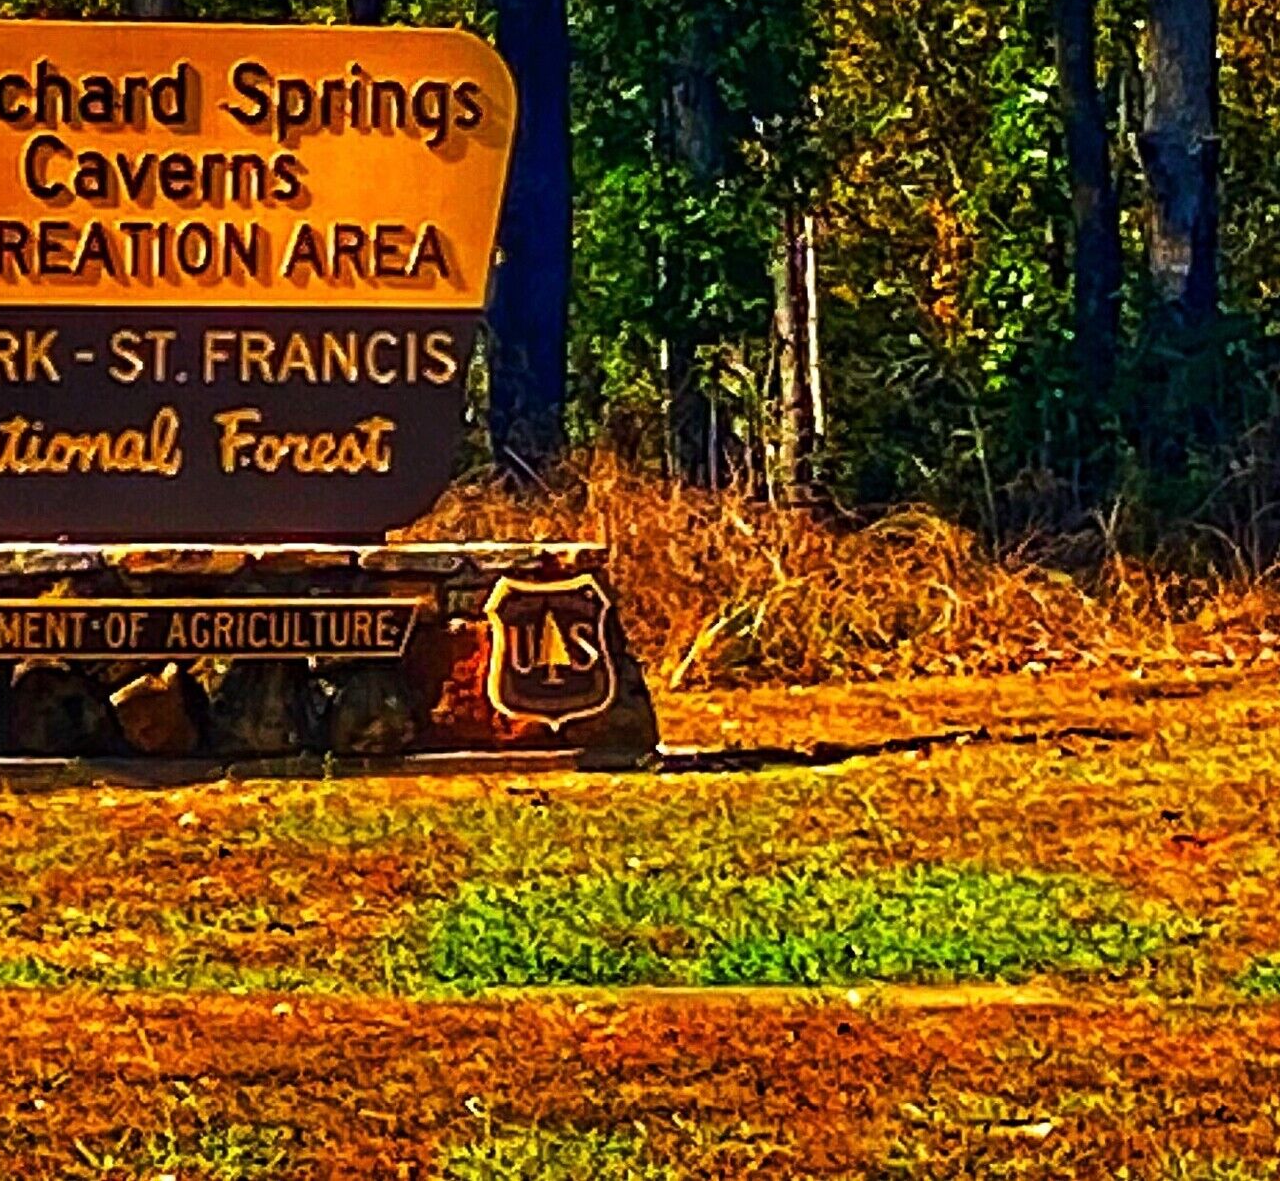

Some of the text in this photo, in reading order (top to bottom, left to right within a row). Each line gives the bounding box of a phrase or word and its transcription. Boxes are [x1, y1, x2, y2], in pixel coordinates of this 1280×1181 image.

[222, 61, 484, 149] Springs
[24, 134, 300, 201] Caverns
[282, 222, 451, 279] AREA
[108, 329, 189, 384] ST.
[202, 331, 457, 385] FRANCIS
[214, 408, 396, 473] Forest
[104, 612, 149, 649] OF
[166, 610, 396, 649] AGRICULTURE
